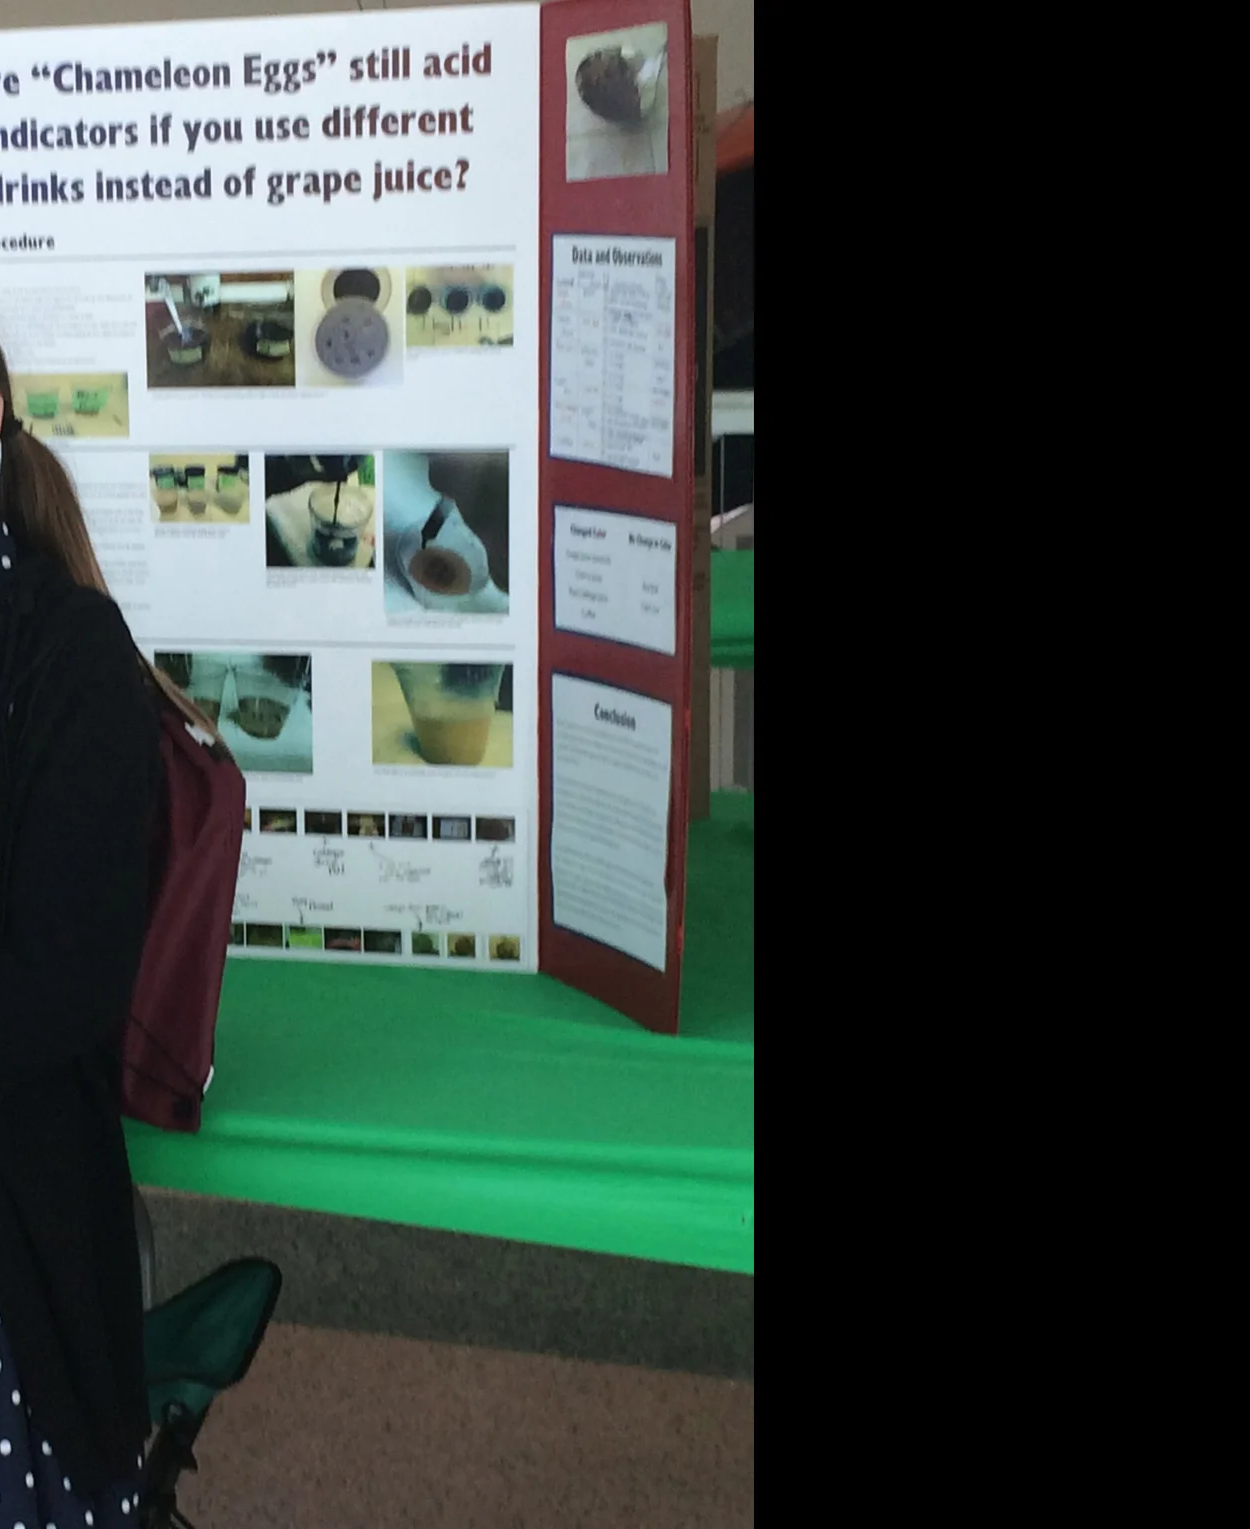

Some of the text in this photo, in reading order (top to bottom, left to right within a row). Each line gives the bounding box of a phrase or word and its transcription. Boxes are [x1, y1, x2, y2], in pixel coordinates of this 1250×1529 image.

[30, 56, 231, 95] “Chameleon
[243, 49, 338, 96] Eggs”
[349, 45, 411, 82] still
[422, 41, 493, 79] acid
[149, 112, 174, 146] if
[182, 117, 244, 154] you
[254, 114, 311, 142] use
[320, 102, 475, 140] different
[95, 166, 213, 203] instead
[223, 164, 258, 199] of
[266, 166, 363, 206] grape
[371, 156, 471, 202] juice?
[572, 245, 663, 267] Data and Observations
[594, 702, 637, 732] Conclusion
